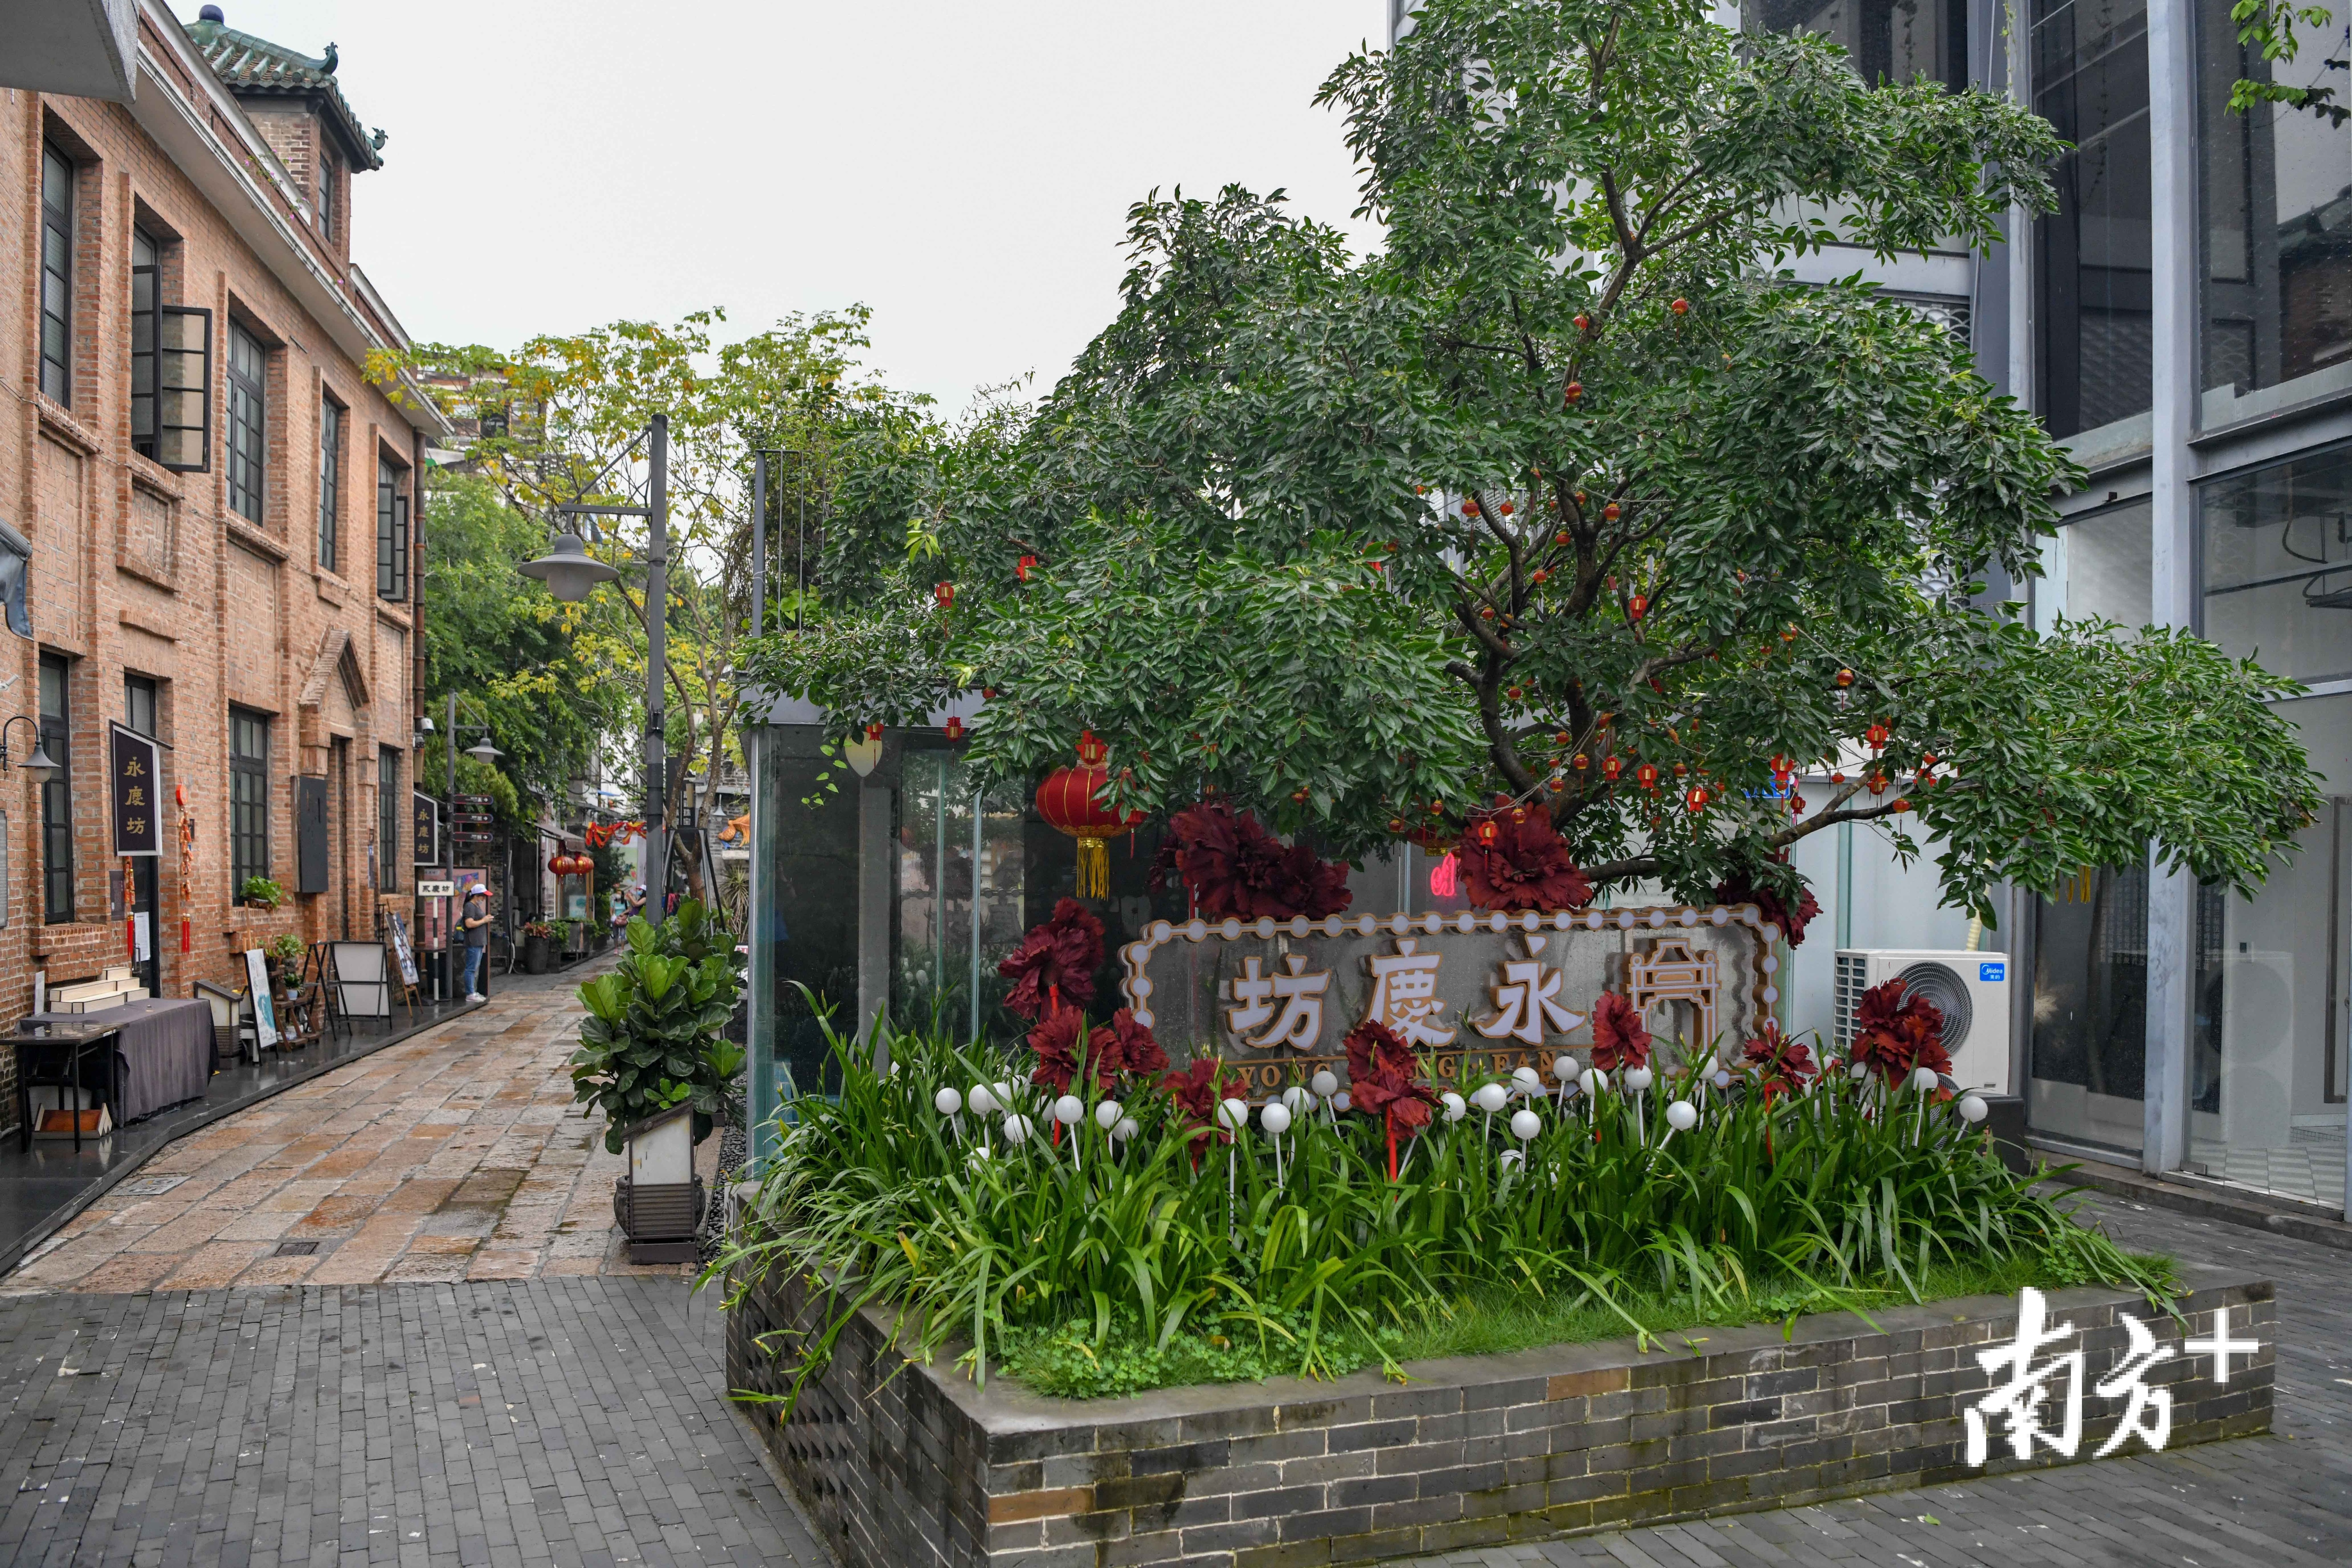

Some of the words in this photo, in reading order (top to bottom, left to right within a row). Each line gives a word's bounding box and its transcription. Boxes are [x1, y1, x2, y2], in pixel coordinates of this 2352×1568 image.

[123, 756, 146, 835] 永慶坊
[417, 808, 430, 854] 永慶坊
